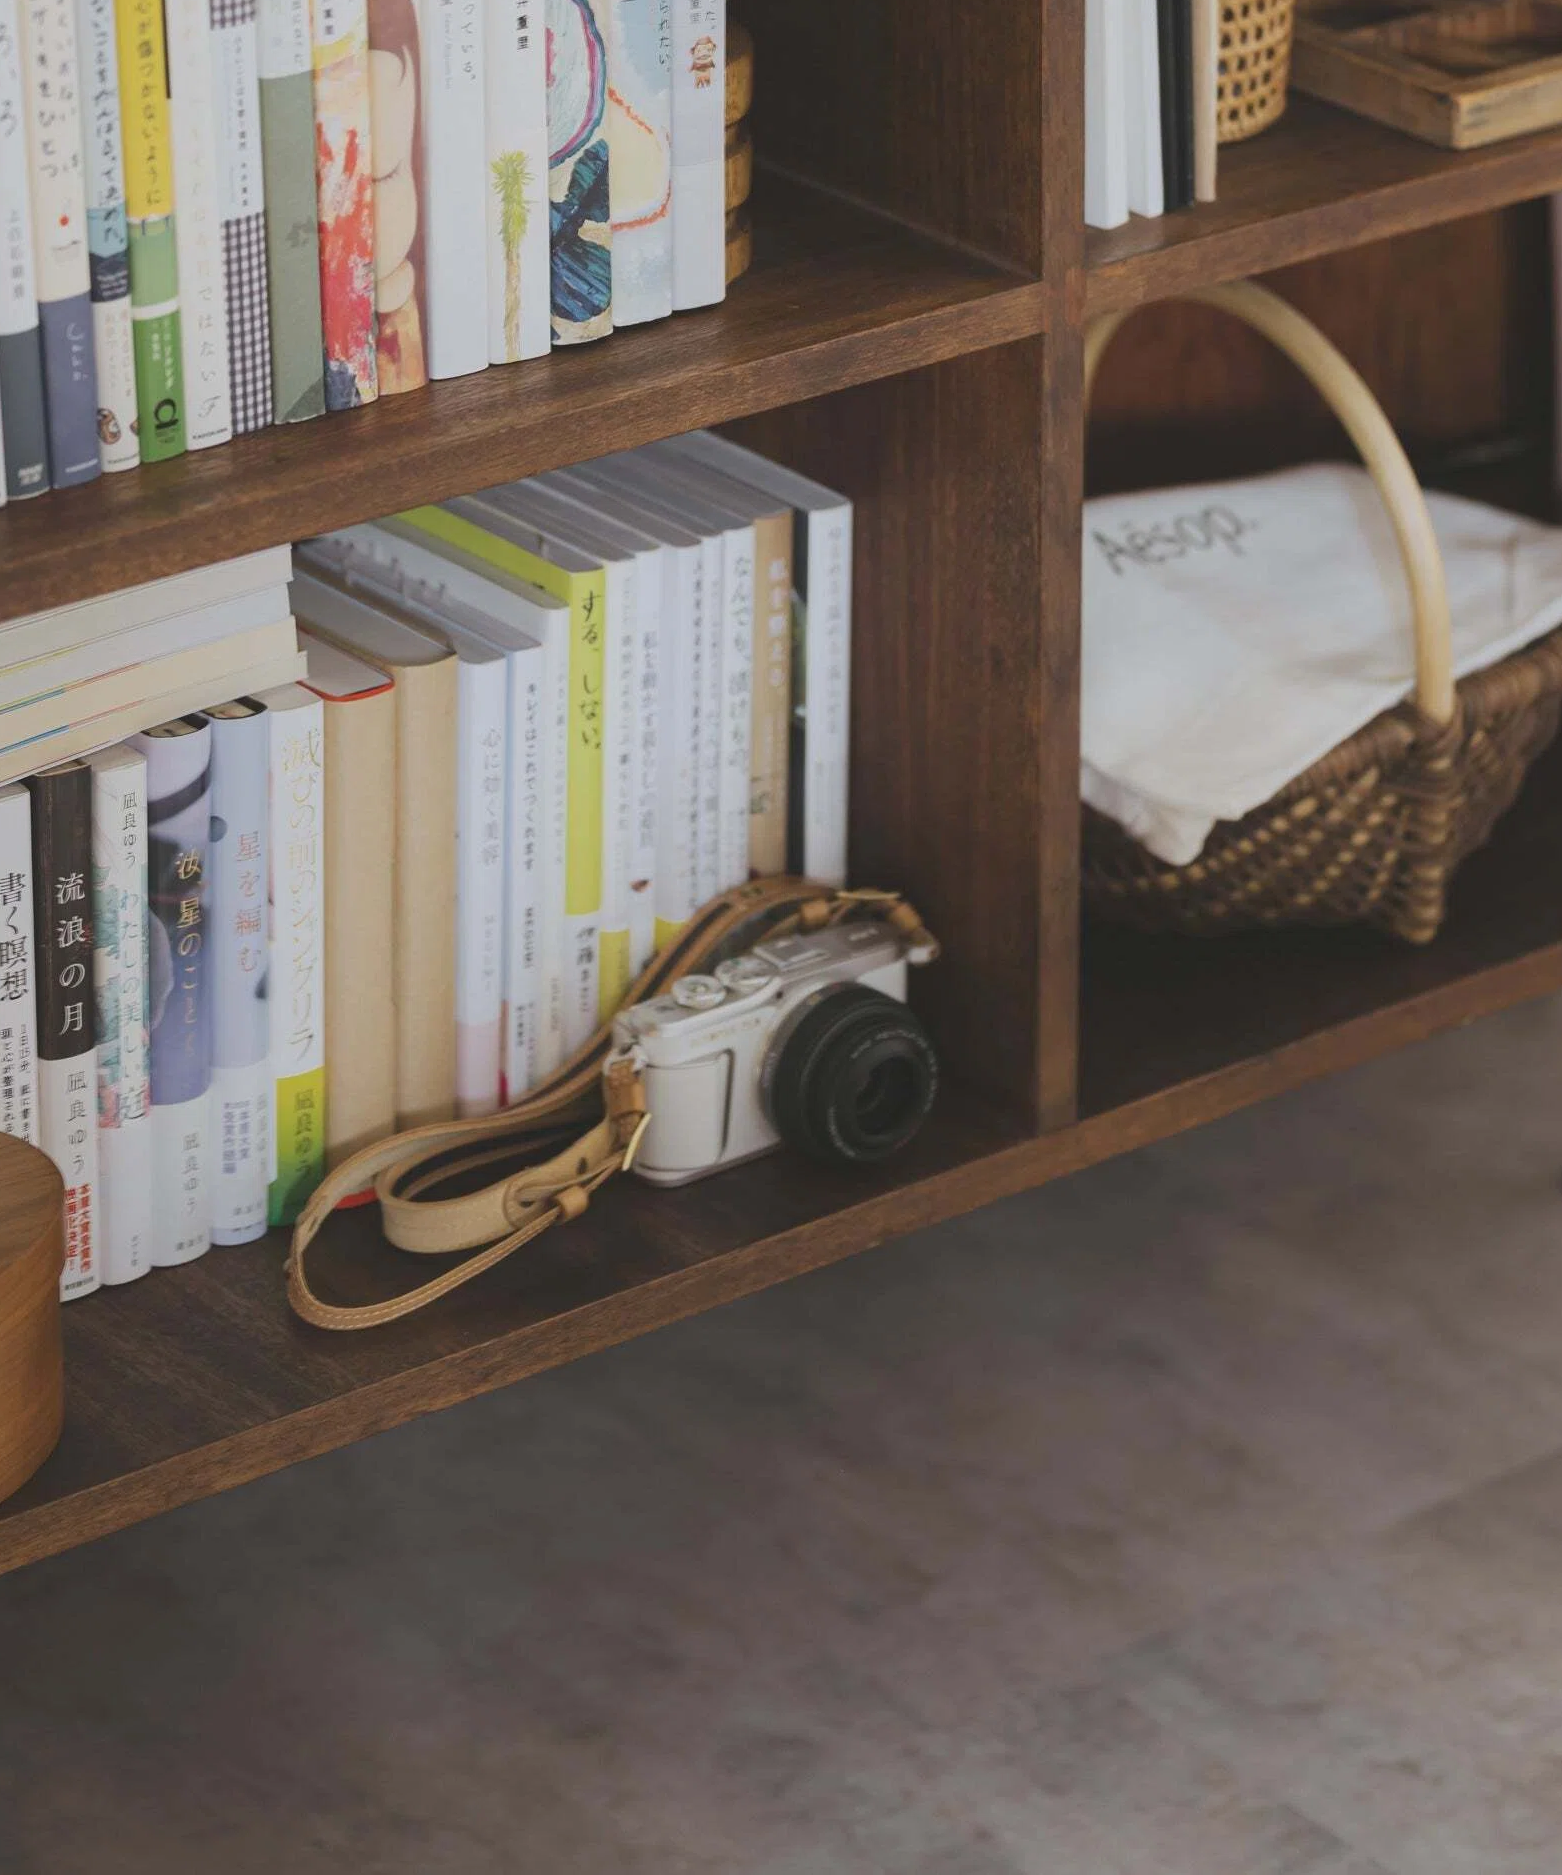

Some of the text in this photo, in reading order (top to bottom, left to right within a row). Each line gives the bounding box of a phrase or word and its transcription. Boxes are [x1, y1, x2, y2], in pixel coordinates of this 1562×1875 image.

[123, 792, 138, 870] 凪良ゆう
[236, 830, 262, 973] 星を編む
[57, 872, 88, 1037] 流浪の月
[67, 1071, 87, 1175] 凪良ゆう
[182, 1131, 201, 1215] 凪良ゆう
